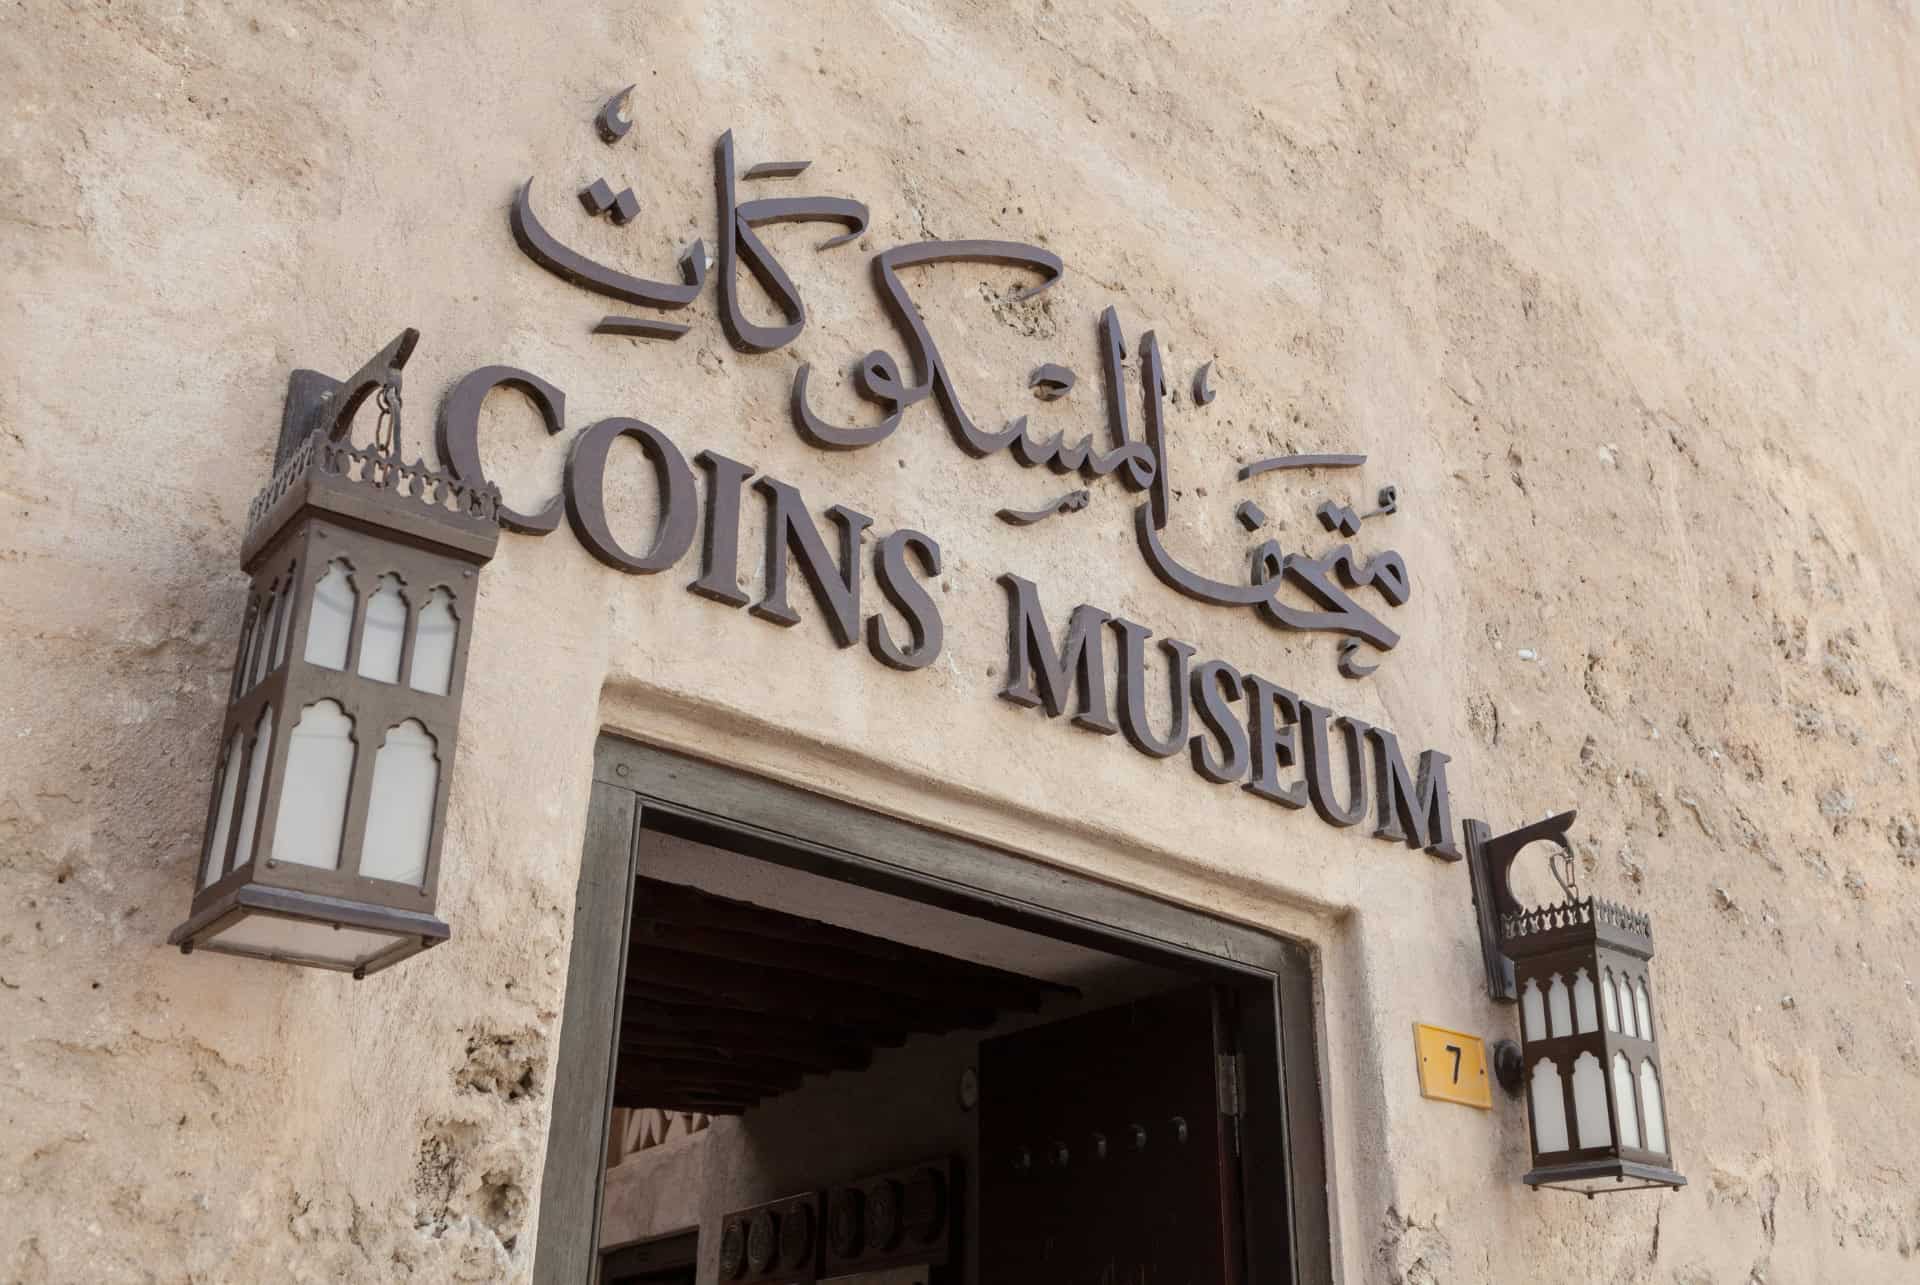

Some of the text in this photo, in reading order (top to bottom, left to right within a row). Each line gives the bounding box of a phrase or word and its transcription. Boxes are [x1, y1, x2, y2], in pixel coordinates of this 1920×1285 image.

[436, 365, 1462, 862] COINS MUSEUM
[1446, 1044, 1461, 1085] 7
